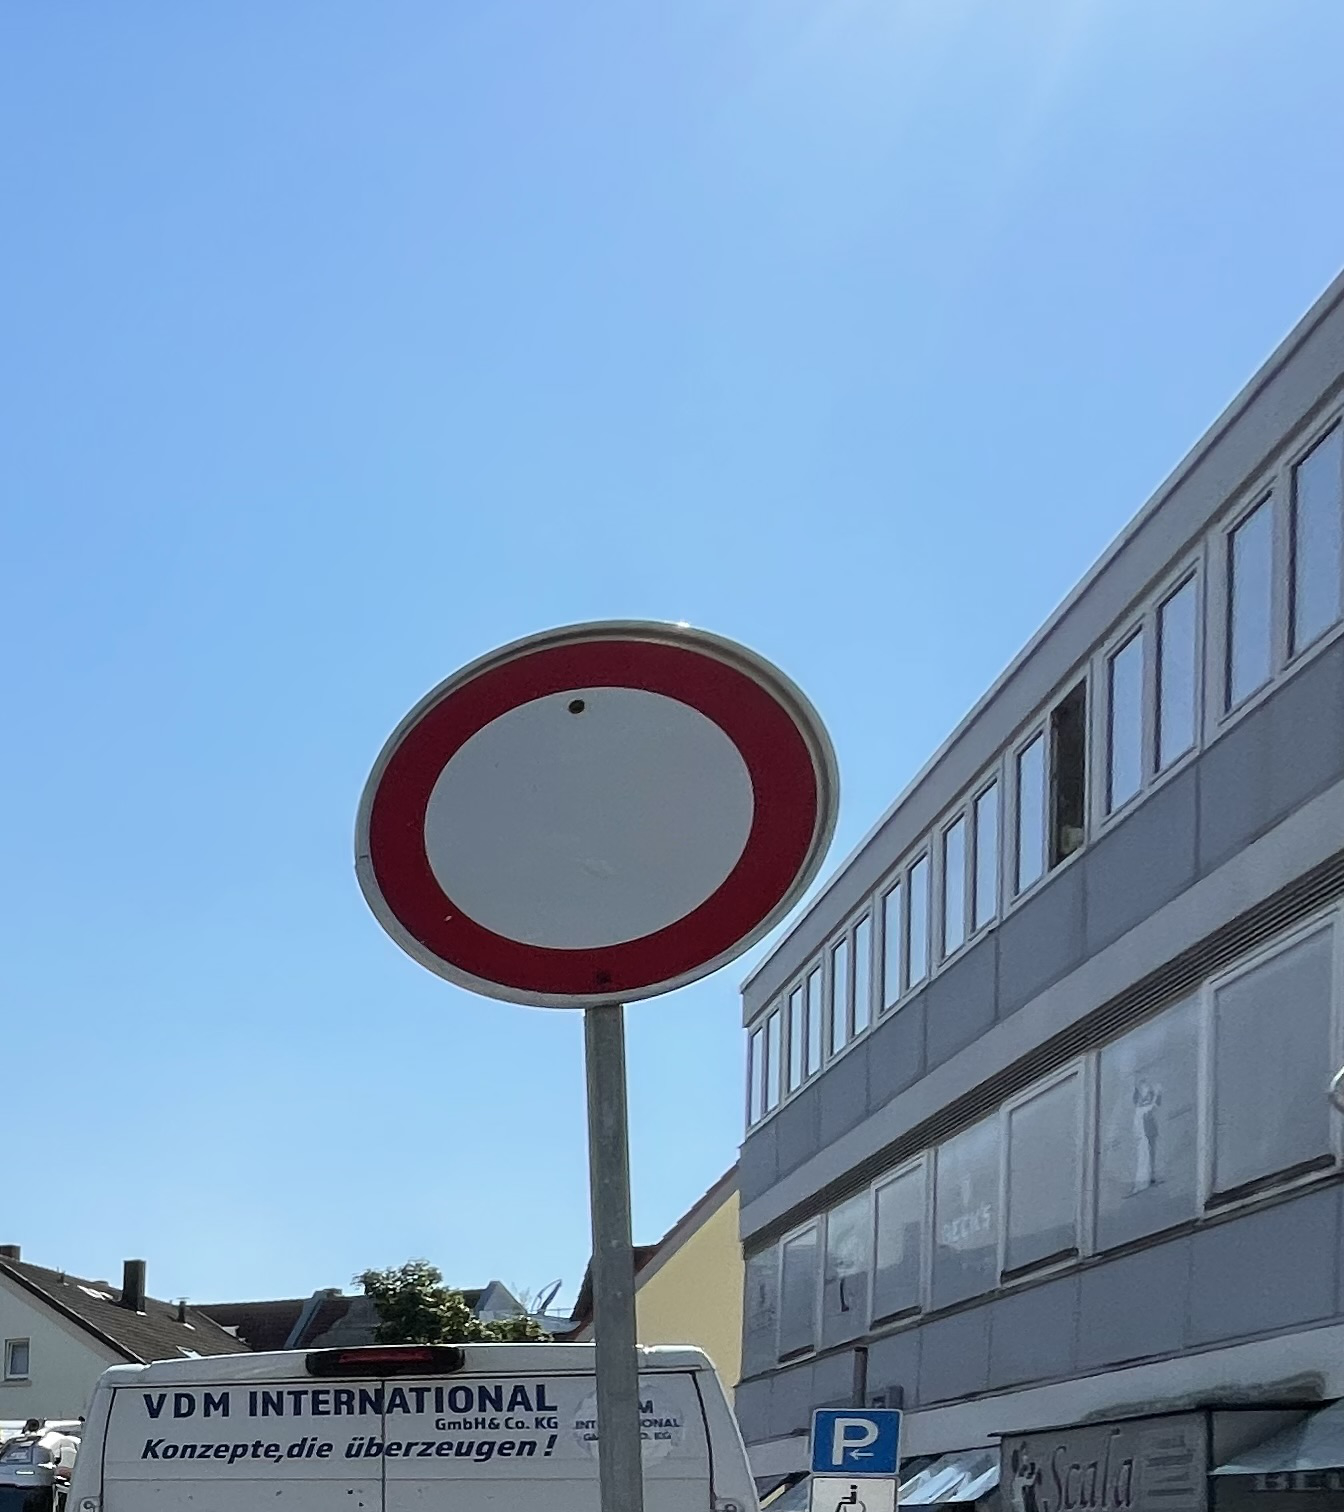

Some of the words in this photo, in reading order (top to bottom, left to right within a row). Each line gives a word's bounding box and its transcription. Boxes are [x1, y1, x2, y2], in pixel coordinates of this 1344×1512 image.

[143, 1391, 230, 1419] VDM
[249, 1384, 558, 1416] INTERNATIONAL
[504, 1417, 530, 1430] Co.
[535, 1417, 558, 1430] KG
[832, 1417, 879, 1465] P
